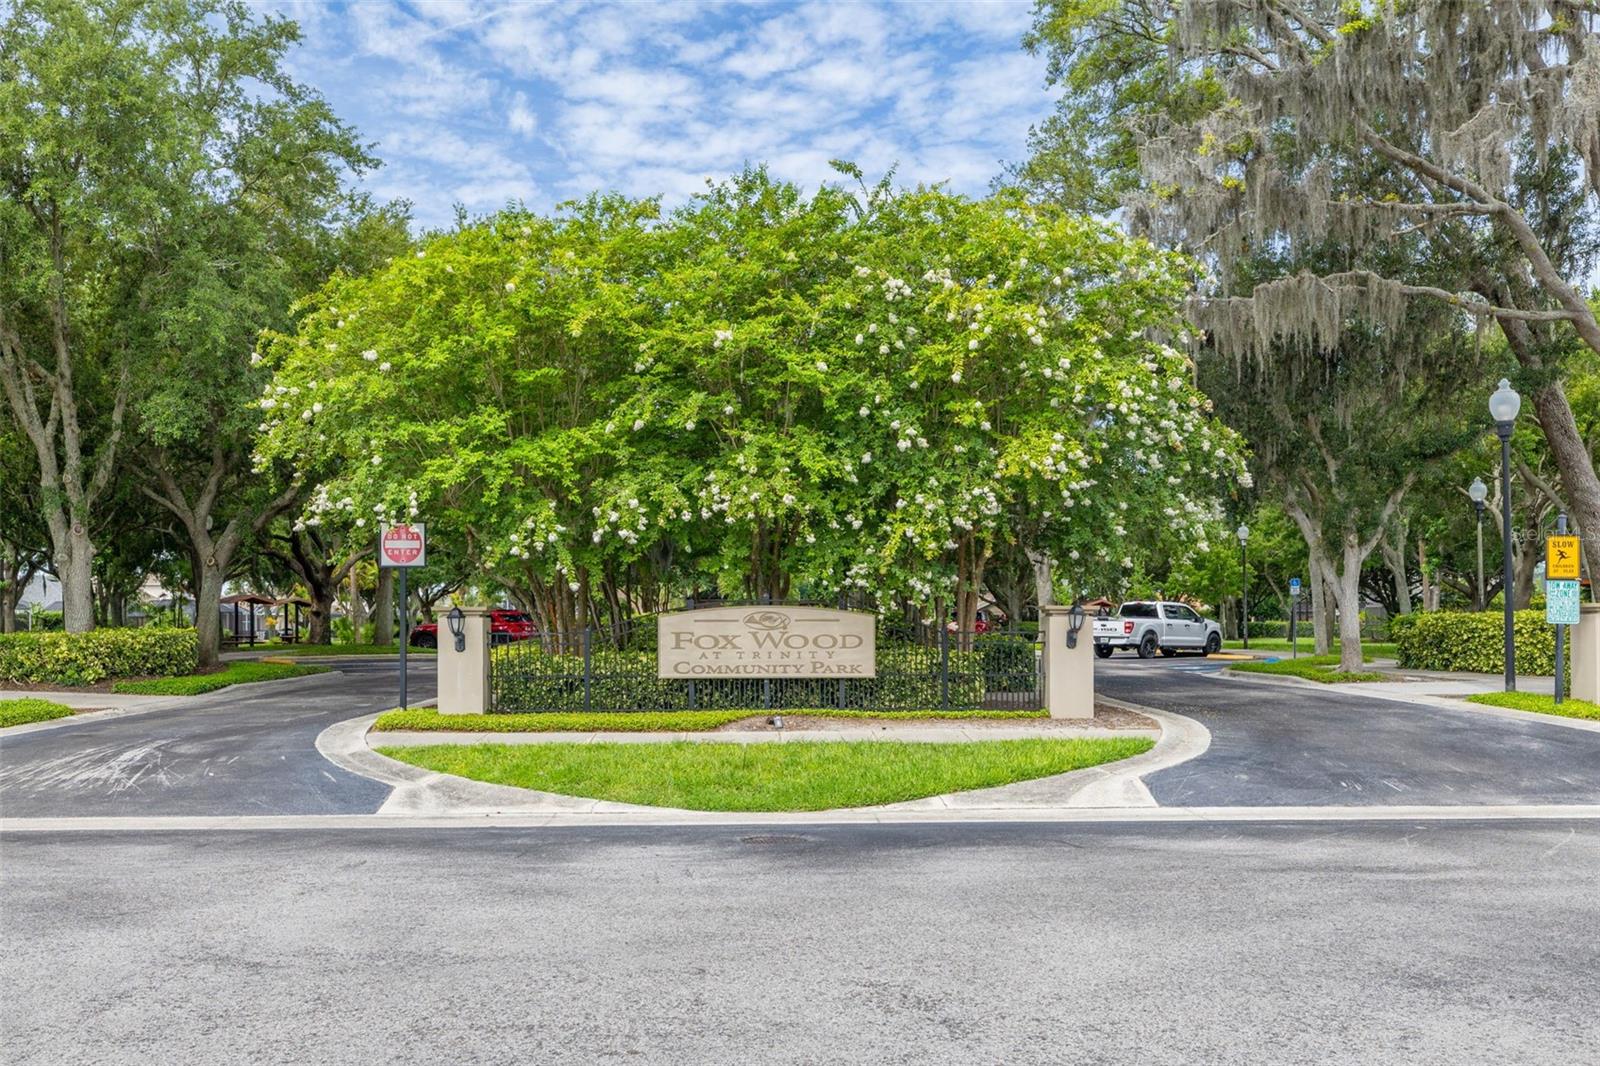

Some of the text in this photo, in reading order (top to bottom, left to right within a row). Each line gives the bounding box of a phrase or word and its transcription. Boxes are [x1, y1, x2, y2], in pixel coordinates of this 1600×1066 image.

[1549, 581, 1578, 589] TOW AWAY
[1556, 589, 1570, 598] ZONE
[671, 631, 864, 650] FOX WOOD
[700, 651, 836, 660] AT TRINITY
[673, 661, 863, 675] COMMUNITY PARK
